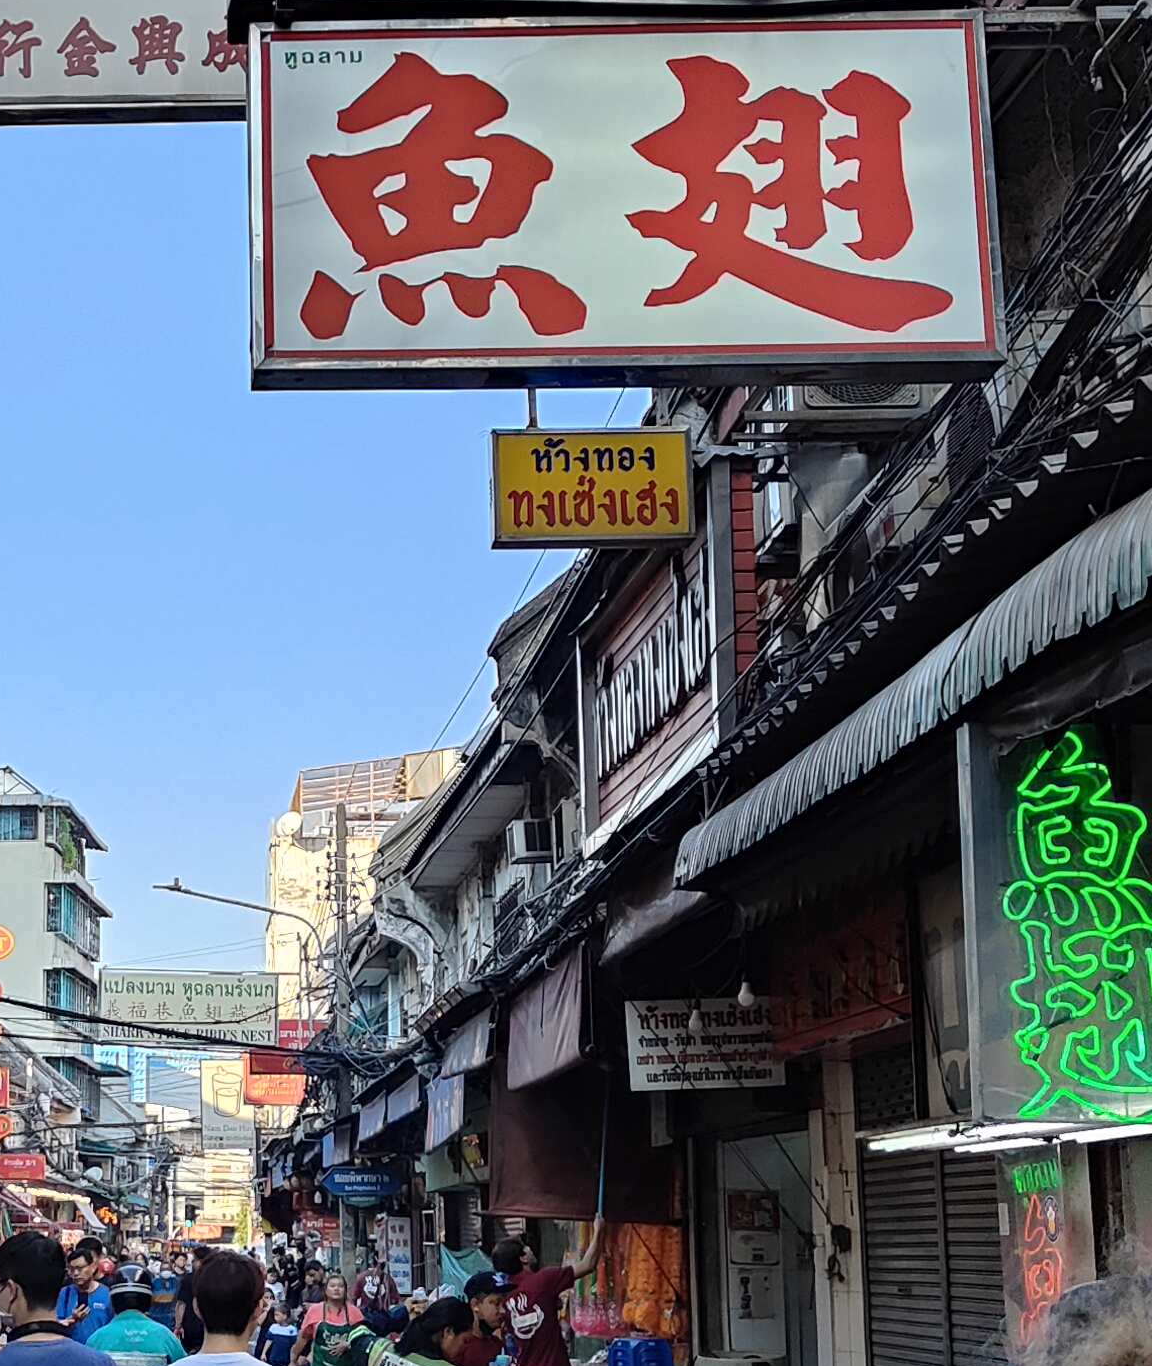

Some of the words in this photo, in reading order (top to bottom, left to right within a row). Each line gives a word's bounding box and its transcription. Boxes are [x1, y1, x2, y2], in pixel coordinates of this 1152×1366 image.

[299, 51, 954, 340] 魚翅
[530, 437, 656, 473] ห้างทอง
[104, 976, 175, 996] แปลงนาม
[183, 977, 274, 1002] หูฉลามรังนก
[241, 1029, 273, 1042] NEST
